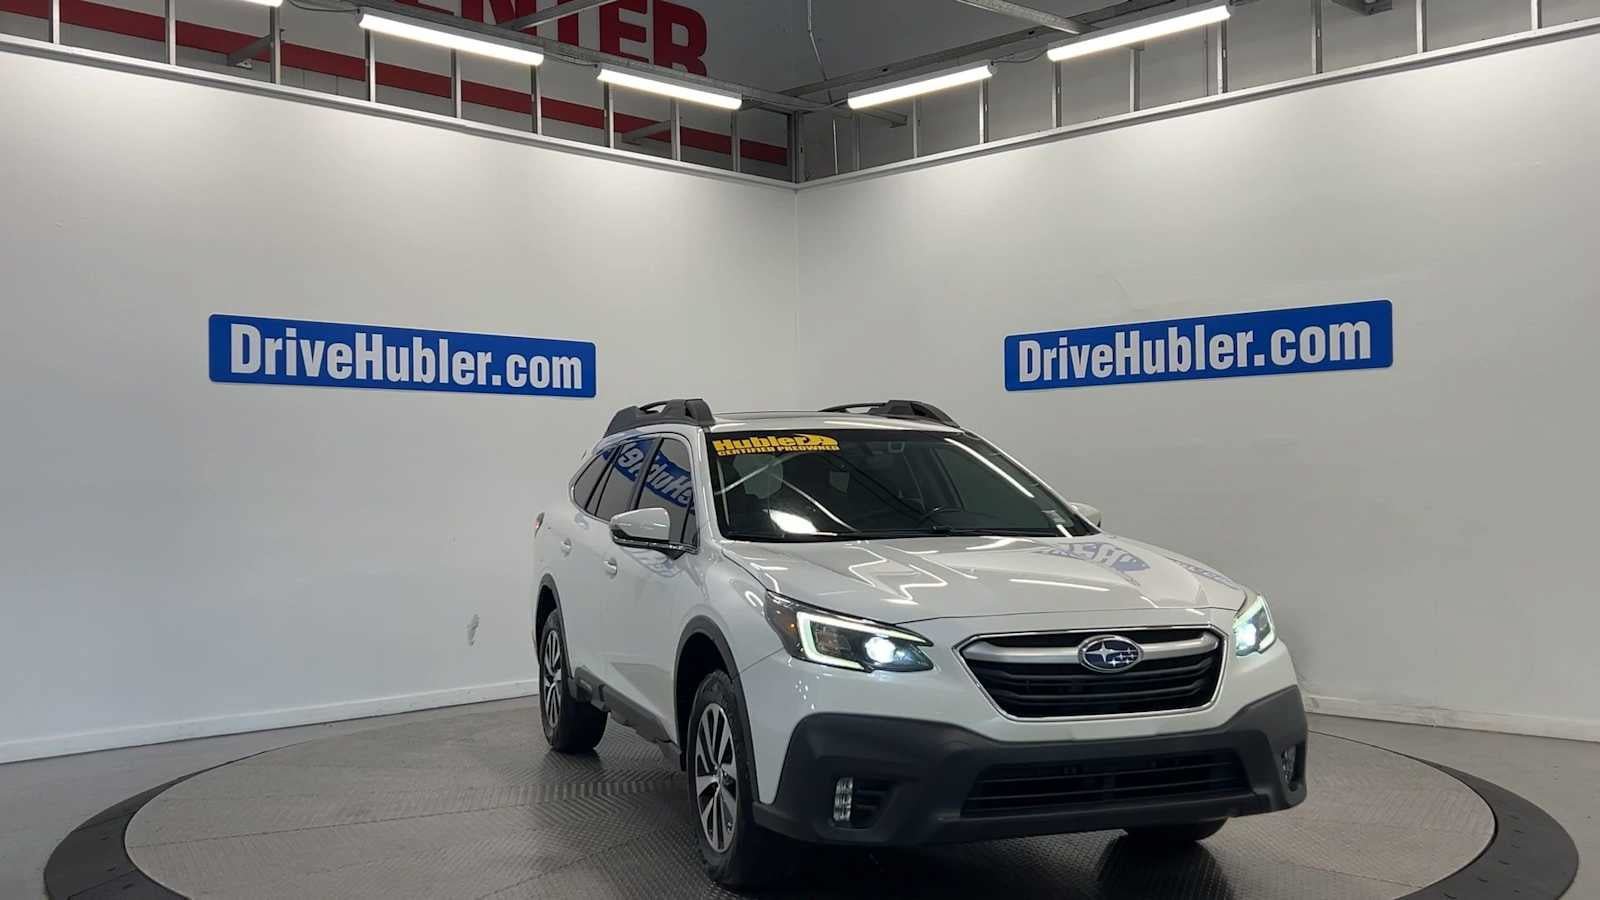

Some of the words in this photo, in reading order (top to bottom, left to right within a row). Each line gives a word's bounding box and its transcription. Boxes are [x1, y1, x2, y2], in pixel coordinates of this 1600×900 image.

[392, 0, 708, 77] NTER
[230, 323, 583, 390] DriveHubler.com
[1018, 320, 1372, 383] DriveHubler.com
[712, 435, 812, 451] Hubler
[717, 446, 776, 456] CERTIFIED
